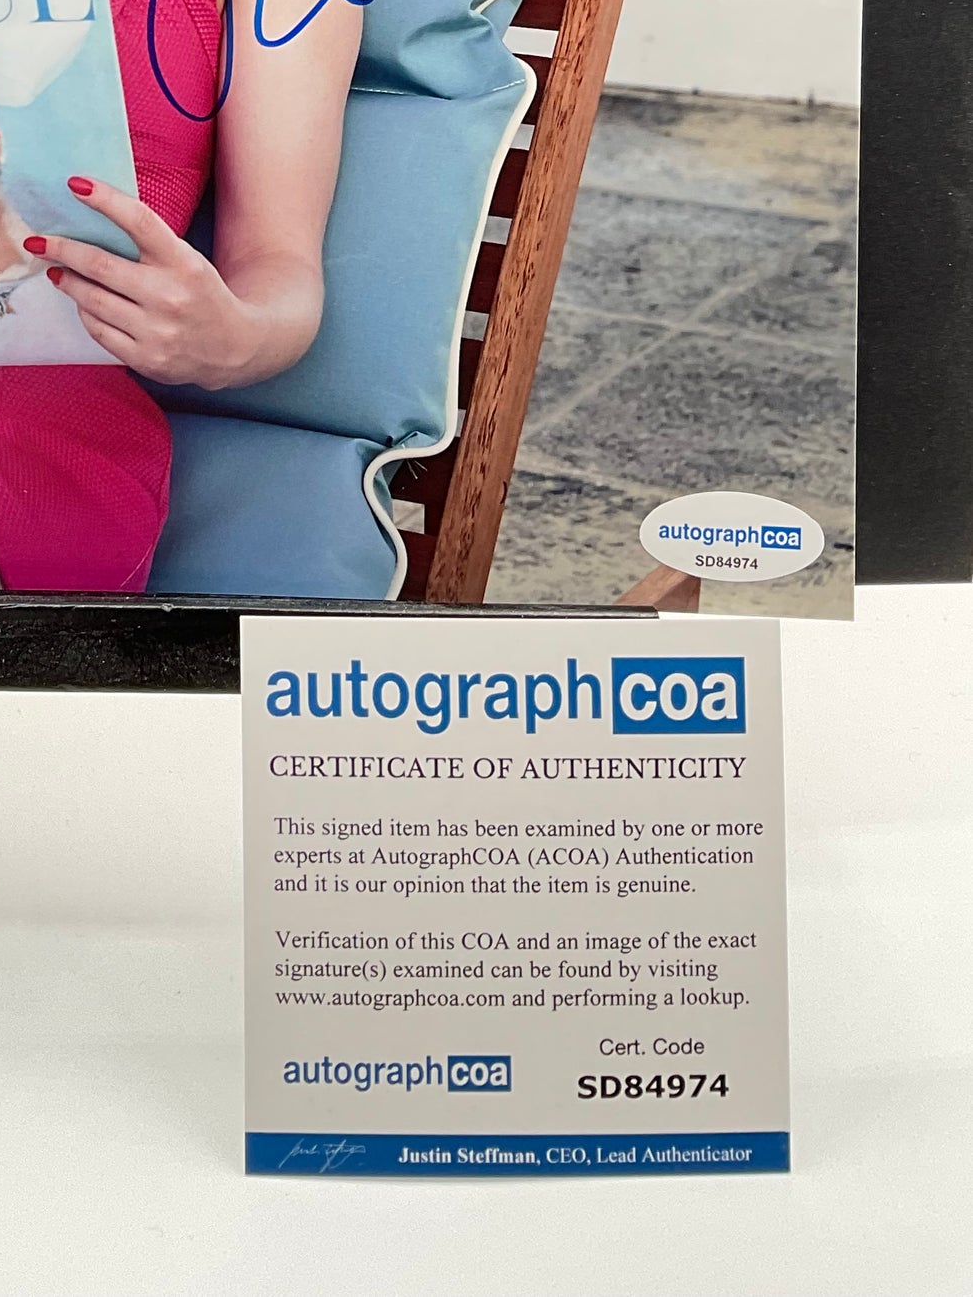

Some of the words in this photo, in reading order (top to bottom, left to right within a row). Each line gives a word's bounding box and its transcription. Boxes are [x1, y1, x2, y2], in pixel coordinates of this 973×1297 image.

[694, 555, 759, 570] SD84974
[269, 755, 465, 779] CERTIFICATE
[472, 757, 514, 780] OF
[519, 756, 747, 780] AUTHENTICITY
[273, 816, 315, 836] This
[321, 817, 383, 841] signed
[390, 818, 431, 837] item
[437, 818, 469, 837] has
[474, 819, 519, 838] been
[524, 818, 616, 838] examined
[622, 819, 645, 842] by
[651, 823, 685, 837] one
[690, 823, 711, 837] or
[715, 822, 764, 836] more
[273, 848, 342, 869] experts
[348, 848, 366, 865] at
[371, 846, 521, 870] AutographCOA
[527, 847, 609, 870] (ACOA)
[615, 845, 754, 865] Authentication
[274, 873, 308, 892] and
[314, 873, 328, 893] it
[334, 874, 350, 893] is
[355, 879, 388, 893] our
[393, 874, 465, 898] opinion
[470, 875, 507, 894] that
[512, 875, 541, 894] the
[548, 875, 589, 894] item
[595, 875, 611, 894] is
[616, 874, 696, 898] genuine.
[274, 930, 389, 950] Verification
[395, 931, 417, 950] of
[420, 931, 455, 950] this
[461, 932, 510, 951] COA
[516, 932, 550, 950] and
[556, 936, 579, 950] an
[585, 931, 642, 955] image
[647, 930, 671, 950] of
[673, 931, 702, 950] the
[707, 932, 757, 949] exact
[275, 958, 387, 982] signature(s)
[392, 960, 484, 979] examined
[490, 965, 523, 979] can
[529, 960, 552, 979] be
[557, 959, 612, 979] found
[618, 959, 642, 983] by
[647, 958, 719, 982] visiting
[274, 988, 505, 1012] www.autographcoa.com
[512, 988, 545, 1007] and
[551, 987, 658, 1012] performing
[663, 992, 674, 1006] a
[680, 986, 750, 1010] lookup.
[599, 1038, 646, 1056] Cert.
[652, 1037, 705, 1056] Code
[577, 1073, 730, 1100] SD84974
[398, 1146, 452, 1164] Justin
[456, 1147, 541, 1166] Steffman,
[545, 1147, 592, 1166] CEO,
[596, 1146, 637, 1164] Lead
[641, 1145, 753, 1163] Authenticator
